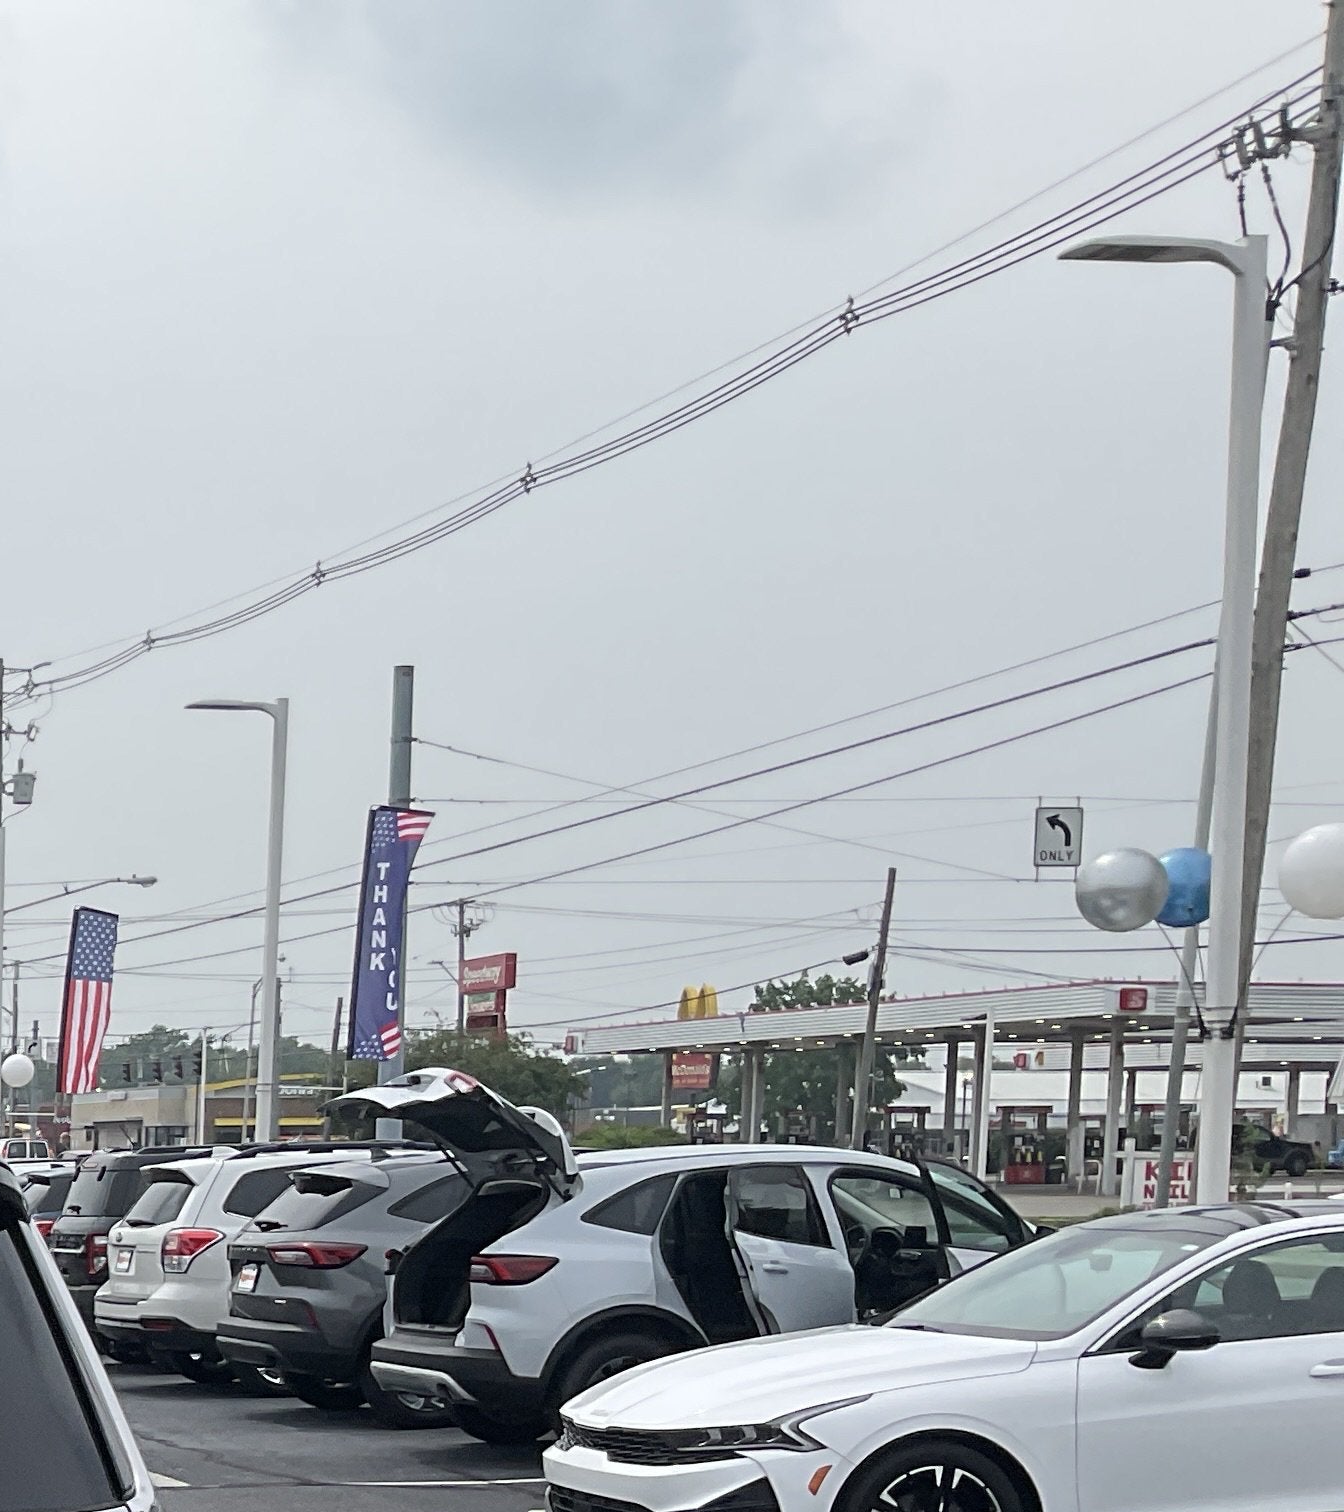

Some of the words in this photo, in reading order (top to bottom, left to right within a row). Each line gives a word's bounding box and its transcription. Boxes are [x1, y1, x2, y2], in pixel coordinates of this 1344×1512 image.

[1039, 850, 1074, 862] ONLY
[369, 862, 391, 971] THANK
[1144, 1184, 1189, 1199] NIL
